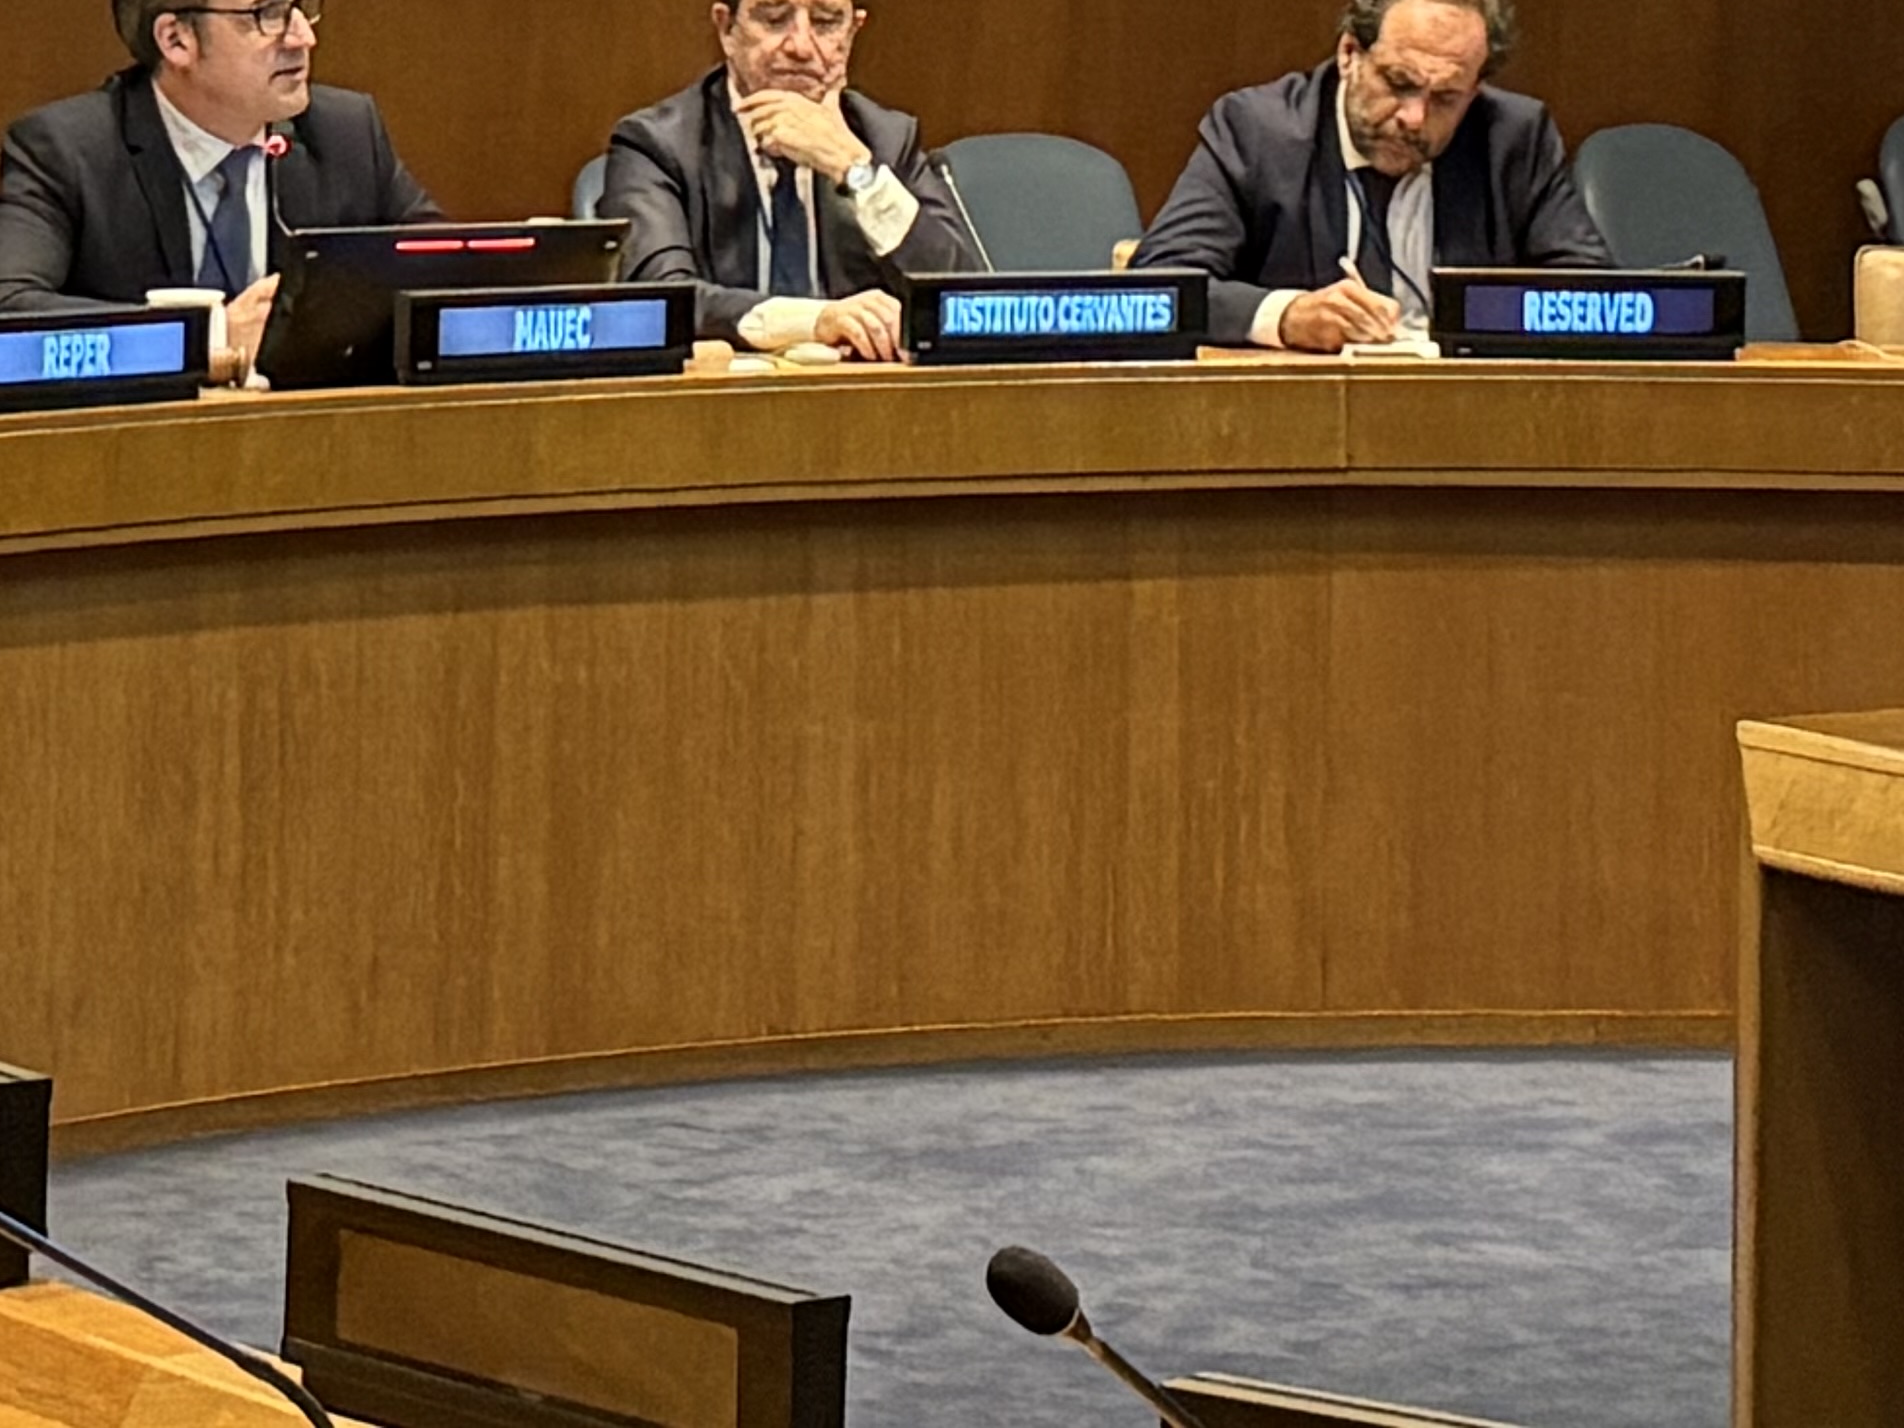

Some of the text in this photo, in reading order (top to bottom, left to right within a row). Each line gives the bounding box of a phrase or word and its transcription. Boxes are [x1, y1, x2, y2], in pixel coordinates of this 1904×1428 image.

[945, 293, 1171, 334] INSTITUTO CERVANTES
[1524, 290, 1655, 333] RESERVED
[43, 332, 111, 379] REPER
